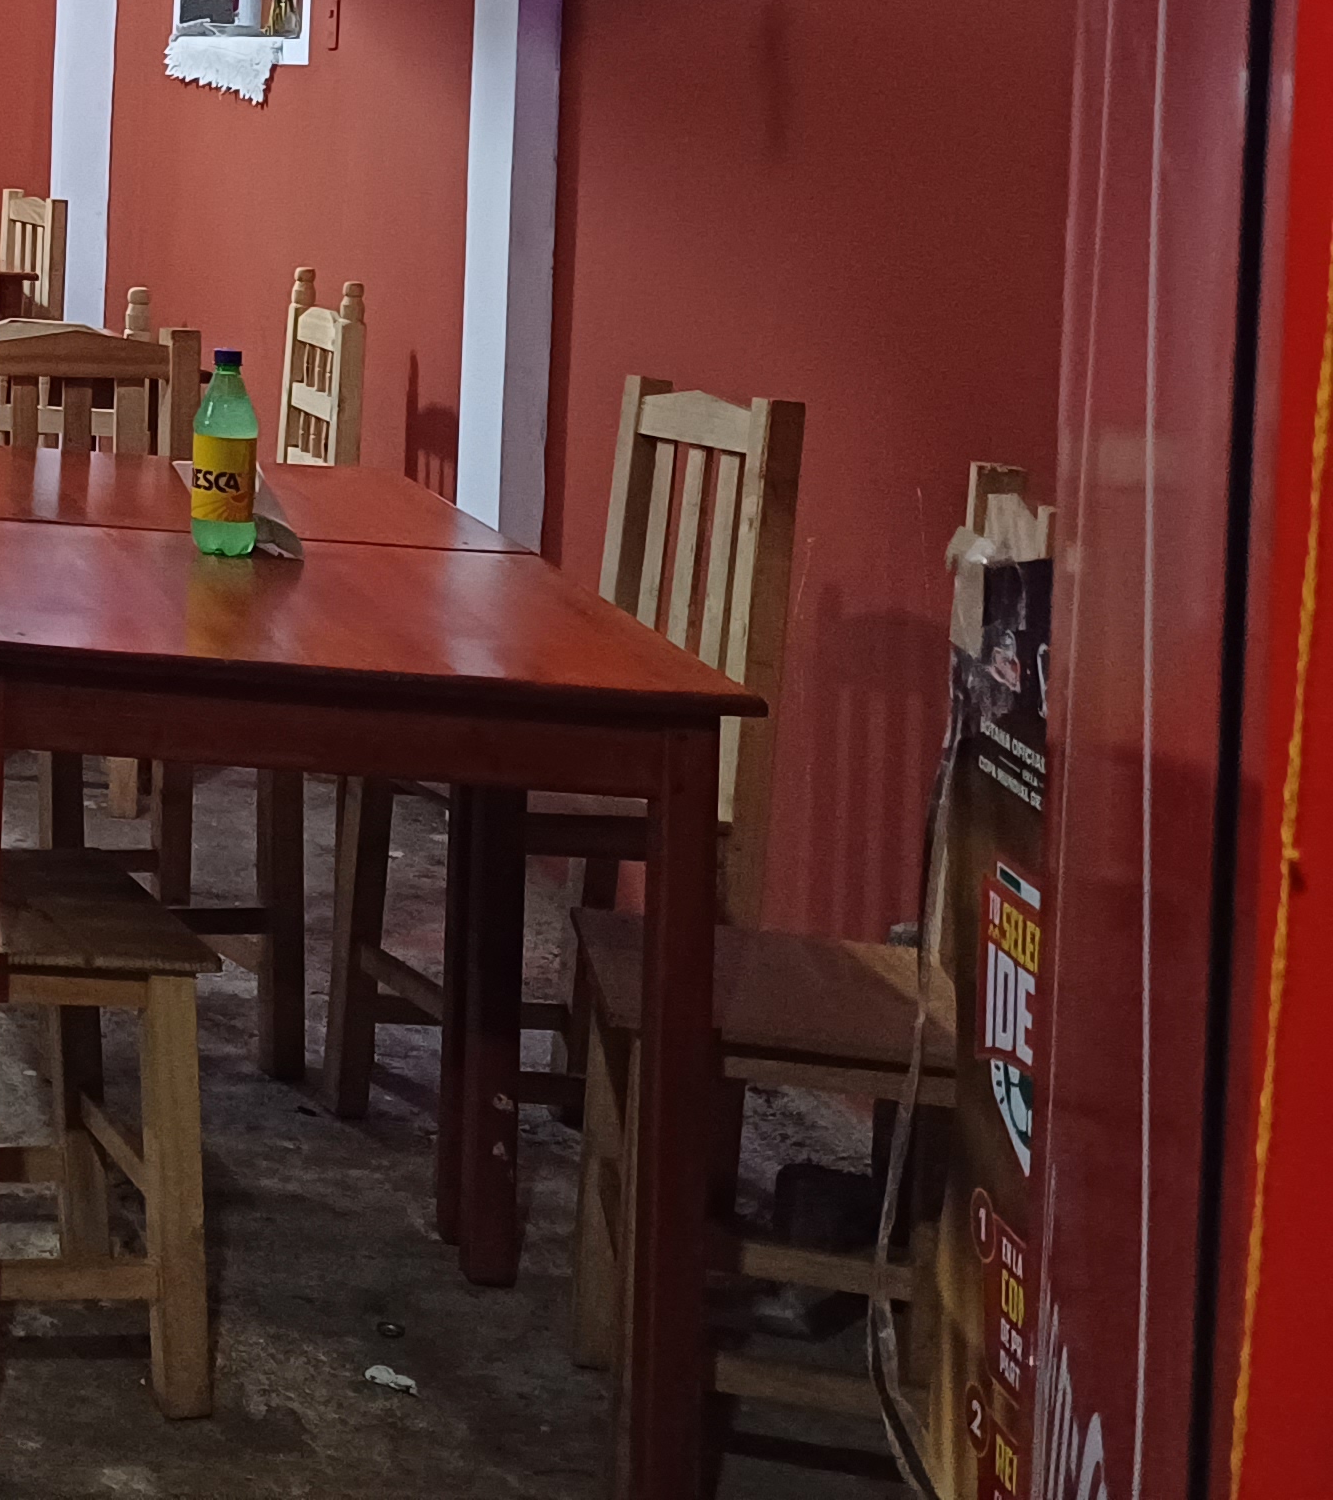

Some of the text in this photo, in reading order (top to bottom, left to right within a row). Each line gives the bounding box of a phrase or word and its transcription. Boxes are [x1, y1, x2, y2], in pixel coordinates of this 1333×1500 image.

[985, 940, 1036, 1067] IDE
[978, 1207, 986, 1242] 1
[971, 1399, 983, 1440] 2
